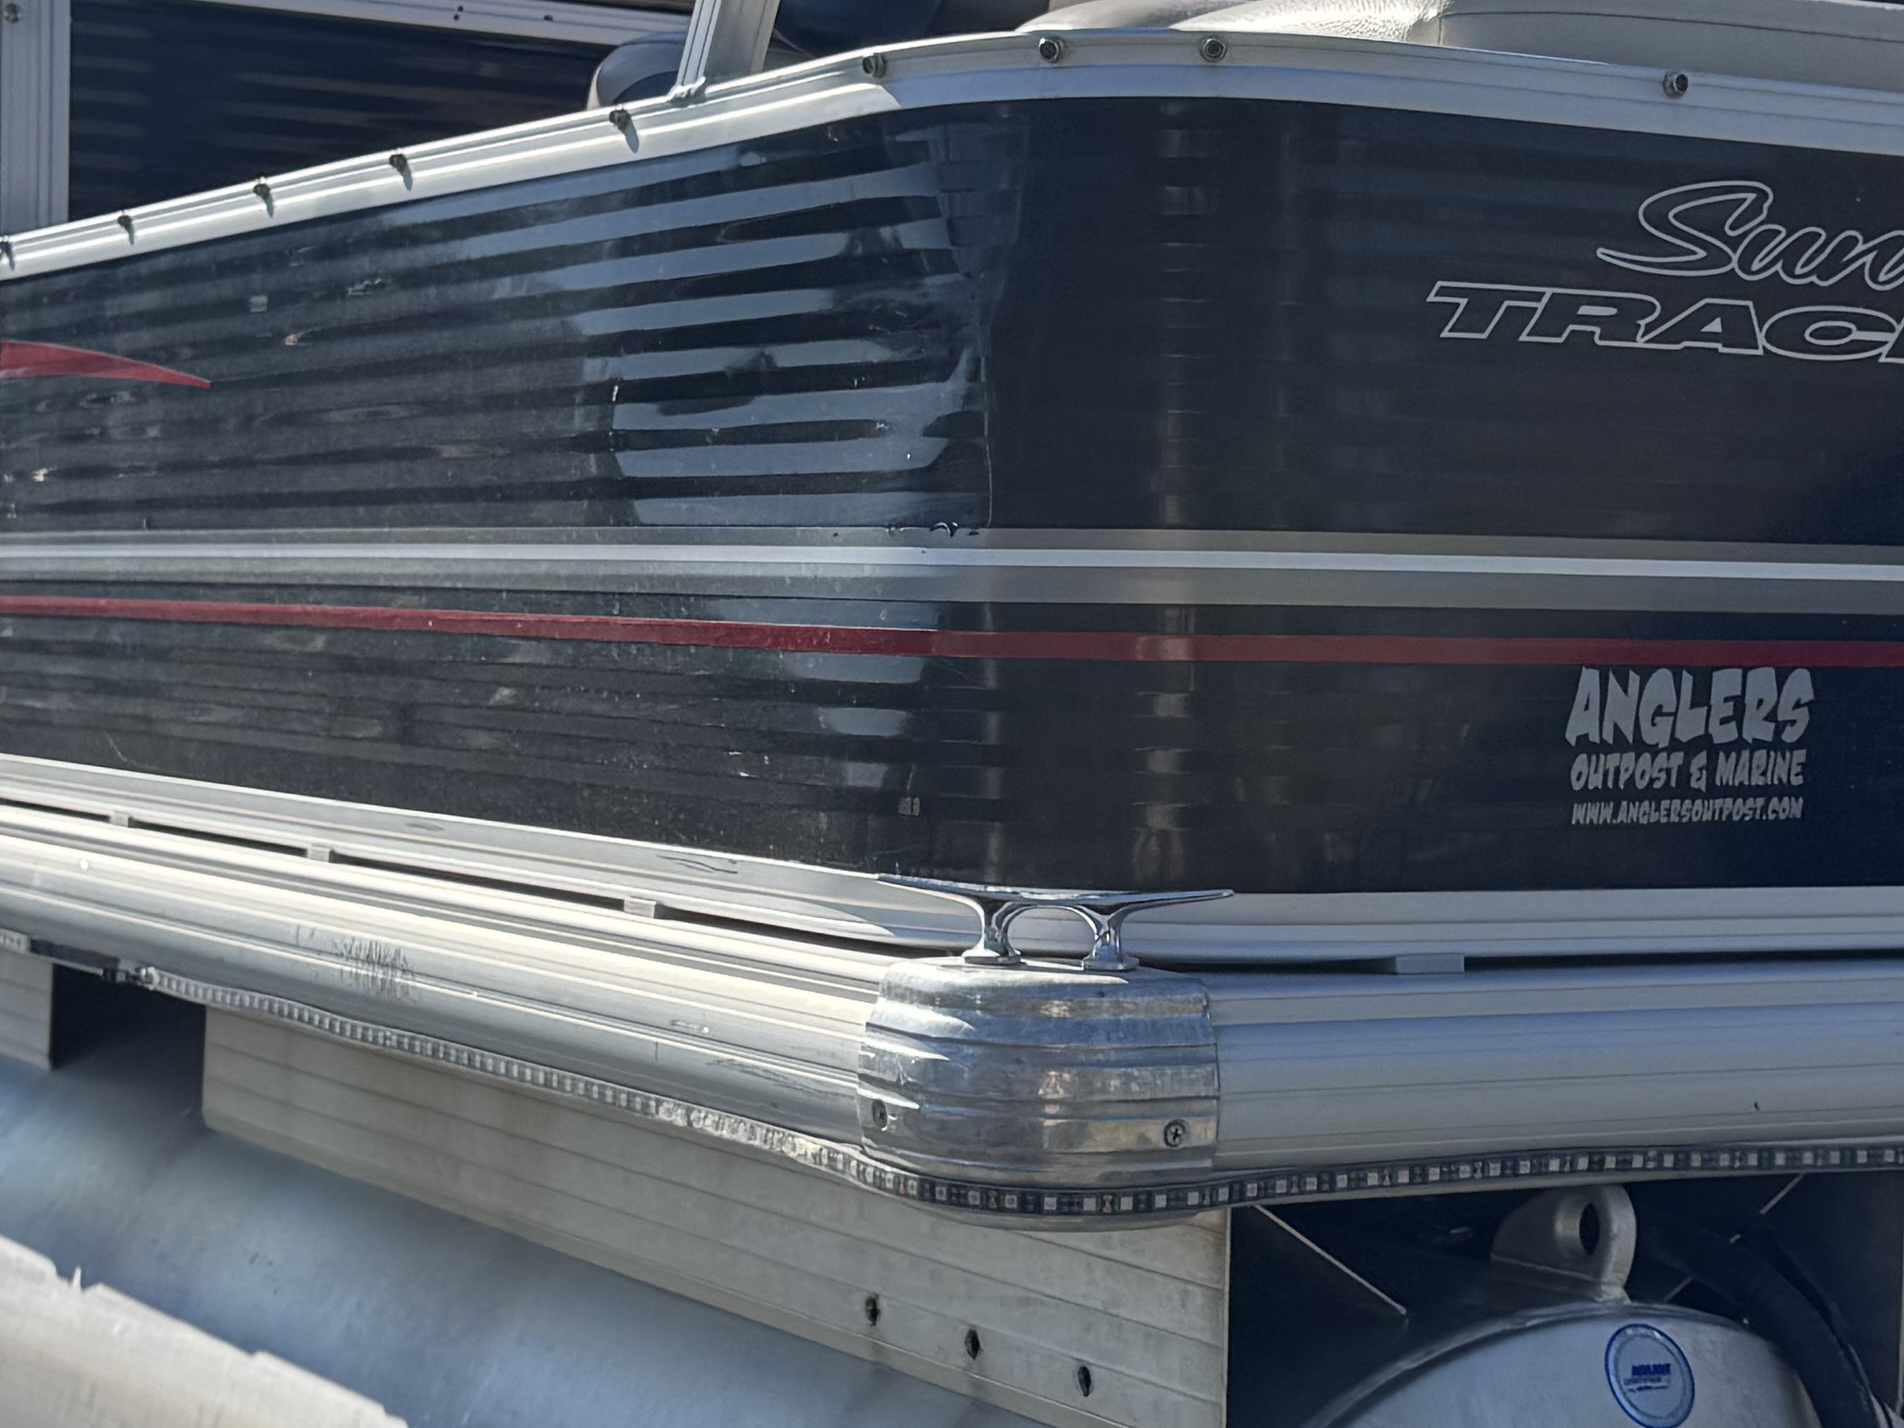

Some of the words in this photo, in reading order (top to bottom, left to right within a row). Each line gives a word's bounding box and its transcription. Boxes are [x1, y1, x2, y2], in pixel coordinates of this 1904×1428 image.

[1565, 666, 1814, 748] ANGLERS
[1571, 752, 1684, 791] OUTPOST
[1690, 750, 1707, 792] &
[1715, 749, 1807, 786] MARINE
[1571, 797, 1804, 825] WWW.ANGLERSOUTPOST.COM
